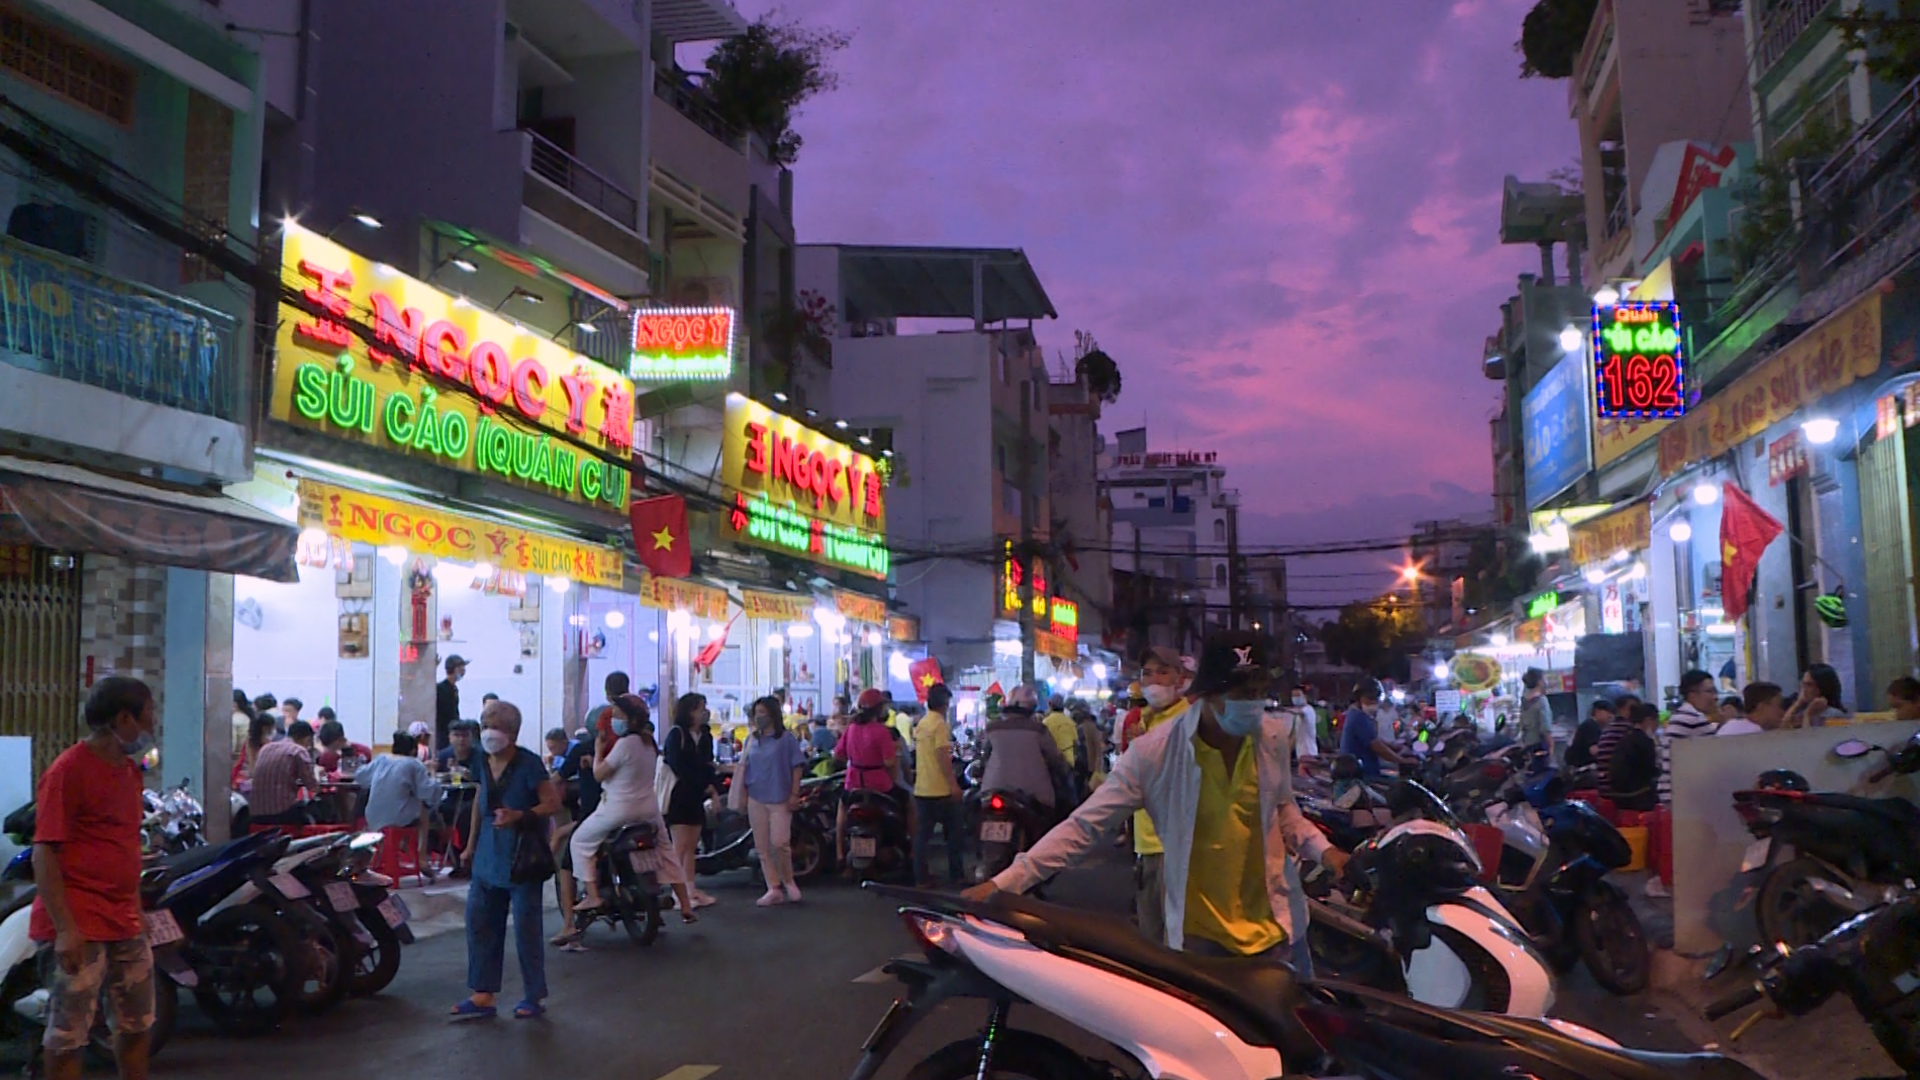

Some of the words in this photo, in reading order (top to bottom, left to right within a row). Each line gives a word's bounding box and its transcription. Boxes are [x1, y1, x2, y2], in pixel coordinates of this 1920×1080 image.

[369, 291, 548, 417] NGỌC
[638, 316, 706, 351] NGỌC
[296, 353, 376, 433] SỦI
[384, 383, 469, 459] CẢO
[1603, 354, 1679, 407] 162
[772, 430, 844, 510] NGỌC
[347, 502, 474, 549] NGỌC
